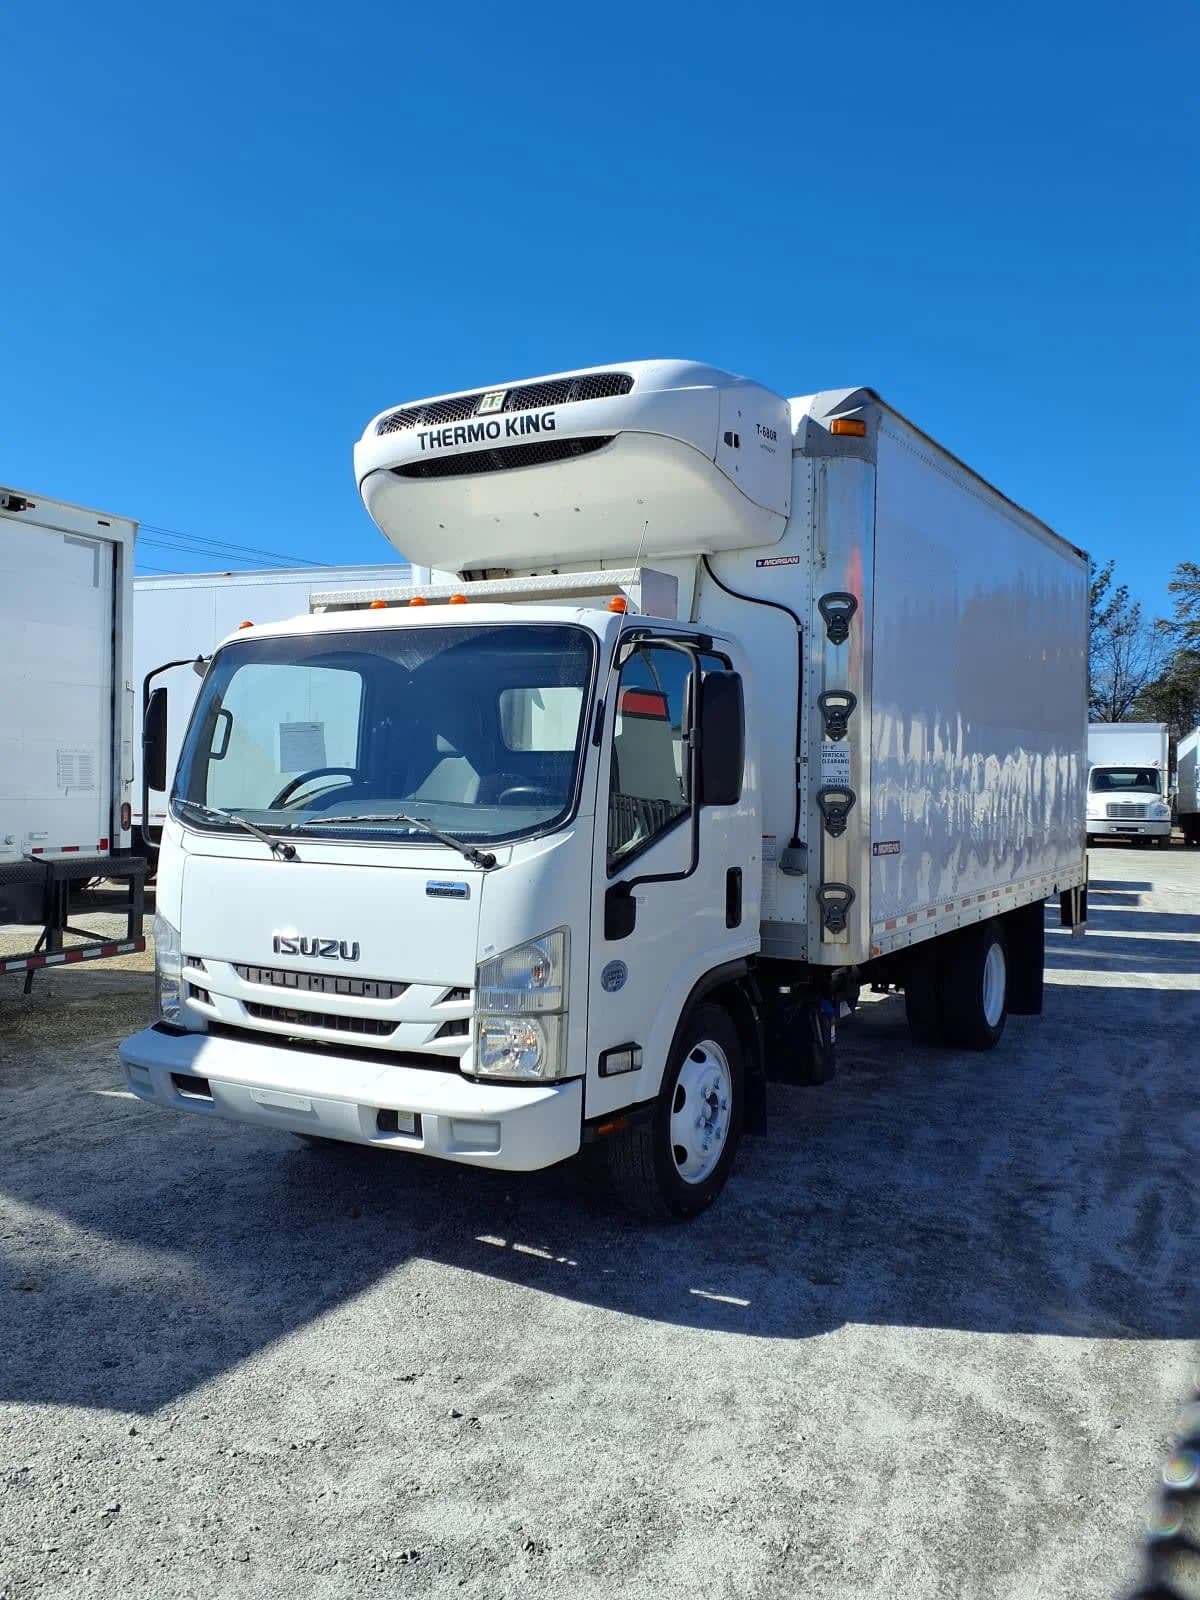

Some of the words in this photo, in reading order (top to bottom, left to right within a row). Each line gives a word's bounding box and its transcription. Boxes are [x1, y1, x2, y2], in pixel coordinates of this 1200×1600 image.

[417, 421, 501, 450] THERMO
[505, 411, 556, 437] KING
[273, 935, 360, 962] ISUZU
